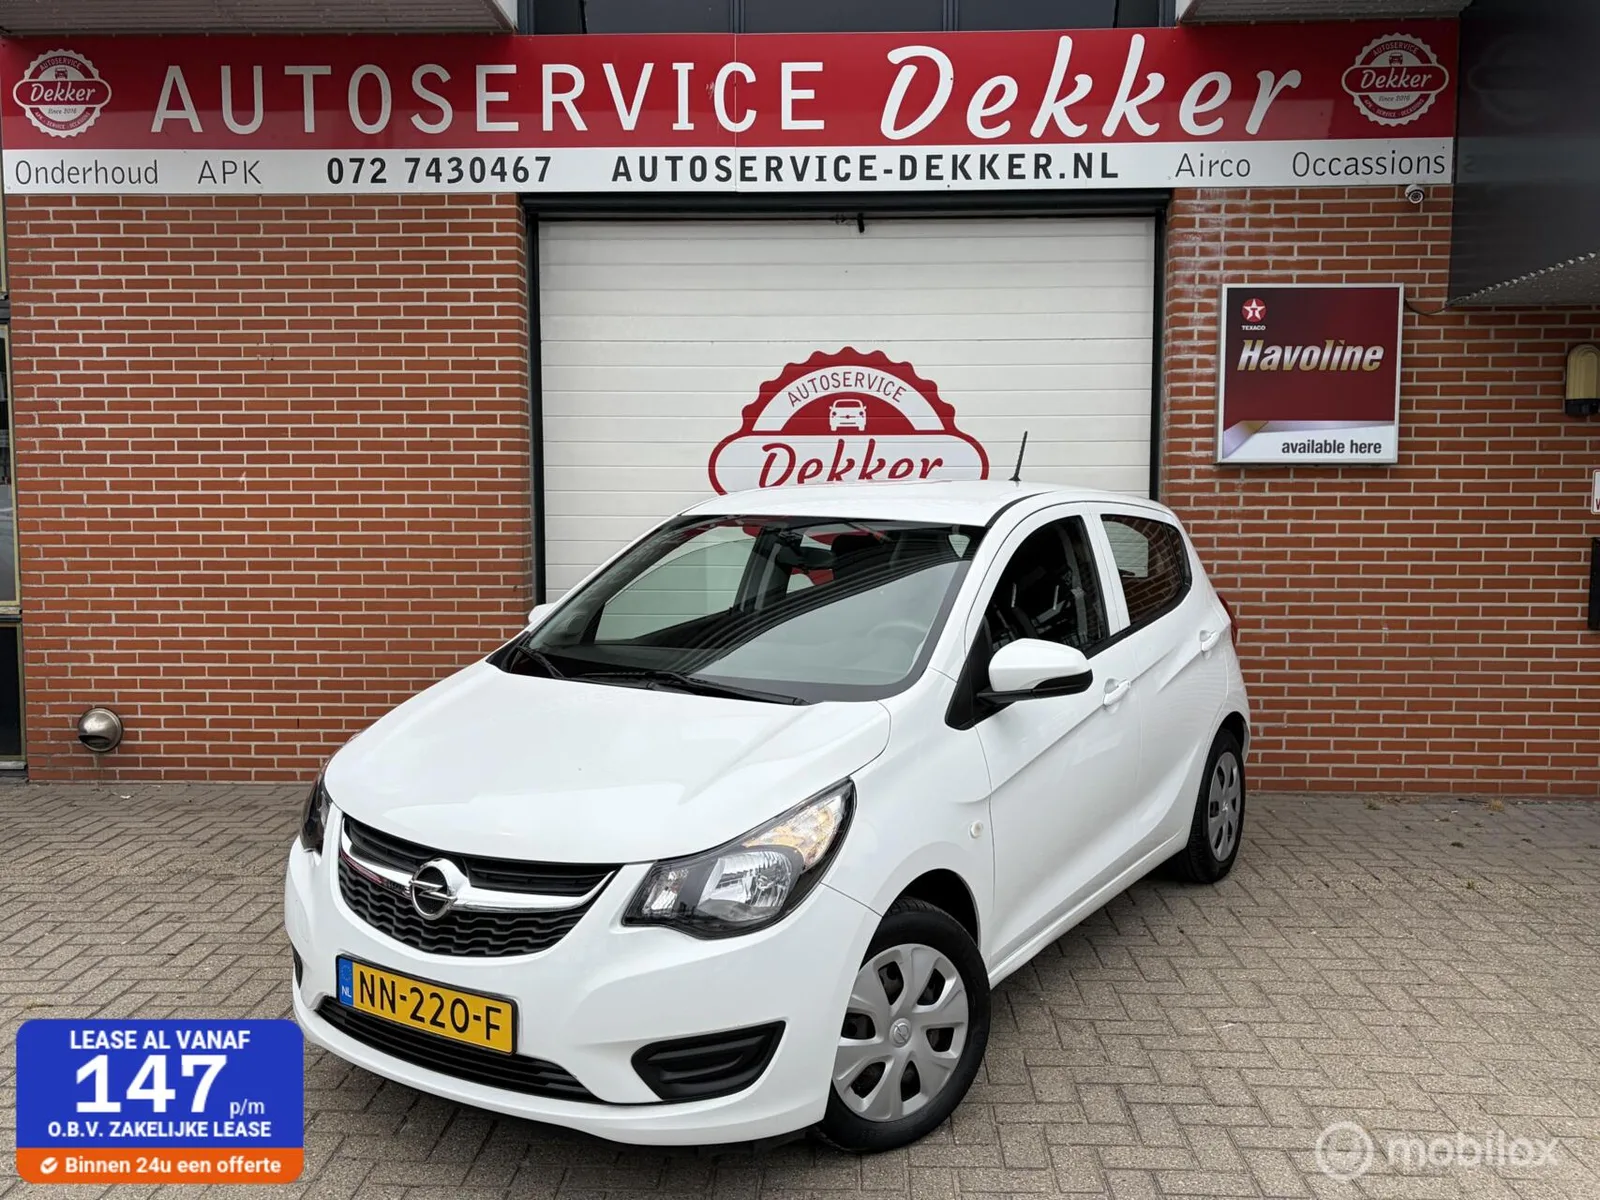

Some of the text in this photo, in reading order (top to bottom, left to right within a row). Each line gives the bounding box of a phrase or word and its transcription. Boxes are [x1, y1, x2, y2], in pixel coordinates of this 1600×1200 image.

[1373, 42, 1419, 56] AUTOSERVICE
[40, 57, 82, 71] AUTOSERVICE
[31, 81, 96, 101] Dekker
[151, 34, 1302, 139] AUTOSERVICE Dekker
[1361, 67, 1432, 89] Dekker
[16, 151, 1446, 184] Onderhoud APK 072 7430467 AUTOSERVICE-DEKKER.NL Airco Occassions
[1237, 339, 1385, 371] Havoline
[787, 371, 907, 407] AUTOSERVICE
[1281, 439, 1382, 454] available here
[758, 438, 943, 488] Dekker
[341, 985, 352, 998] NL
[359, 970, 502, 1041] NN-220-F
